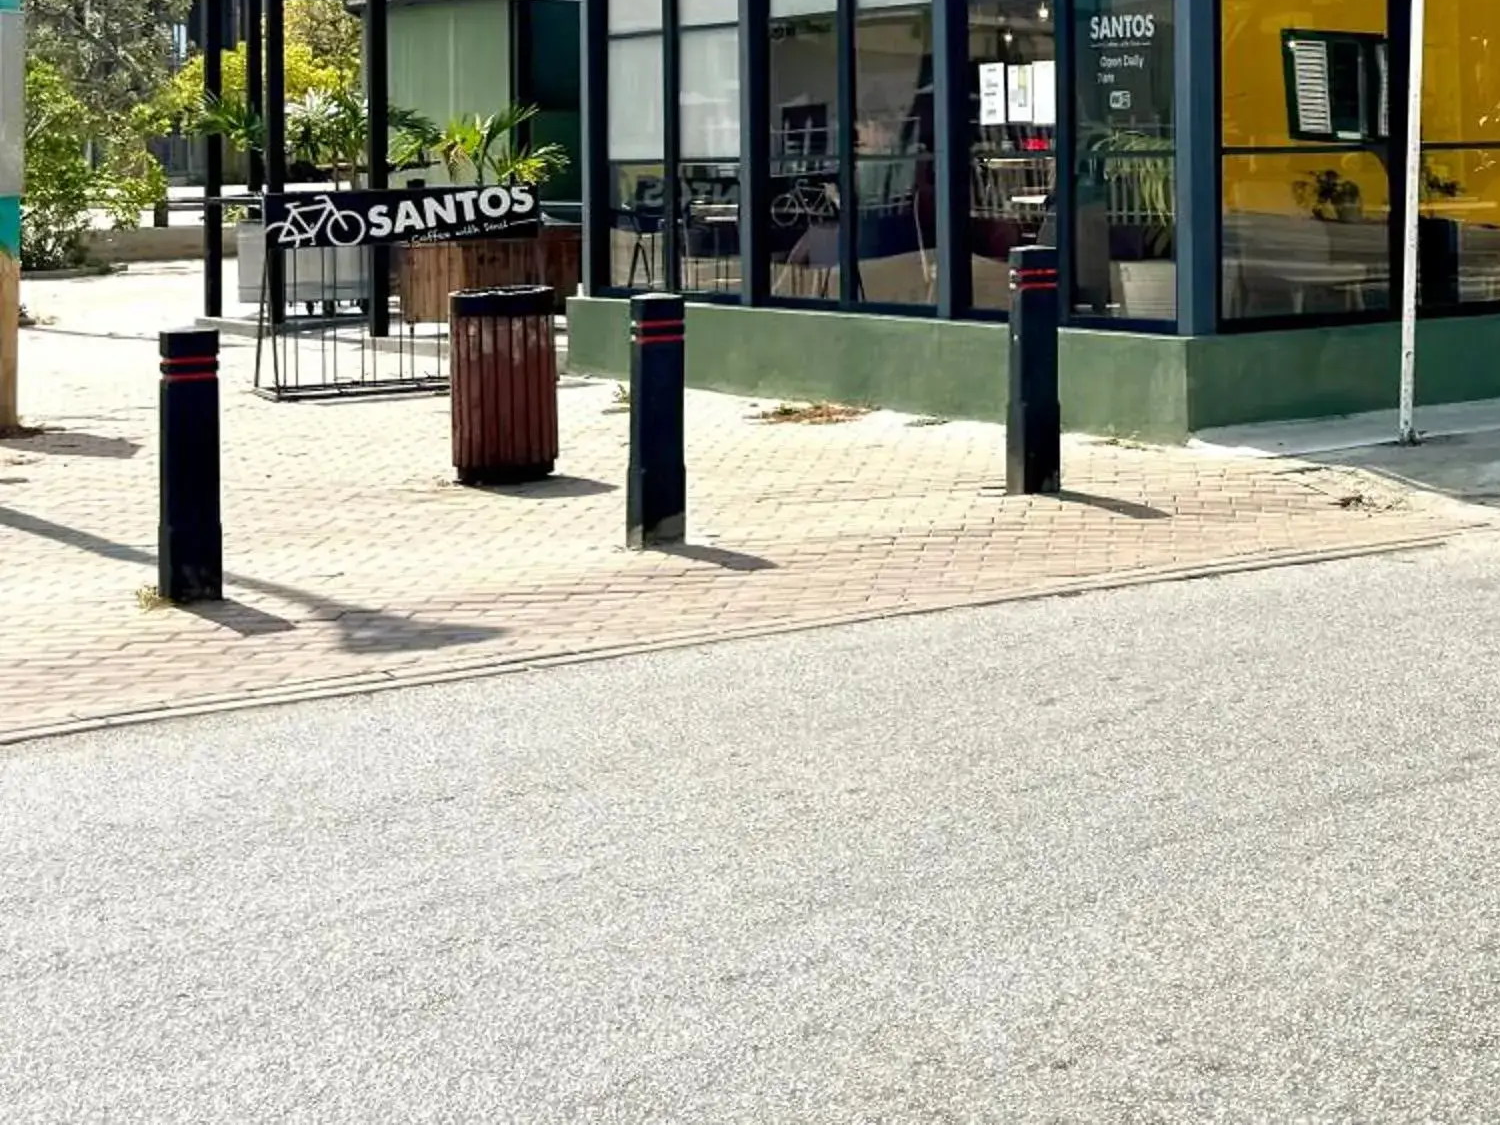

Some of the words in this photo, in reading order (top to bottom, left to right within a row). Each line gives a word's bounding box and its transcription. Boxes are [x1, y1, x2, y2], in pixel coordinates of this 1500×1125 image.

[1090, 14, 1155, 40] SANTOS
[1100, 56, 1122, 68] Open
[1123, 54, 1144, 69] Daily
[368, 186, 534, 238] SANTOS
